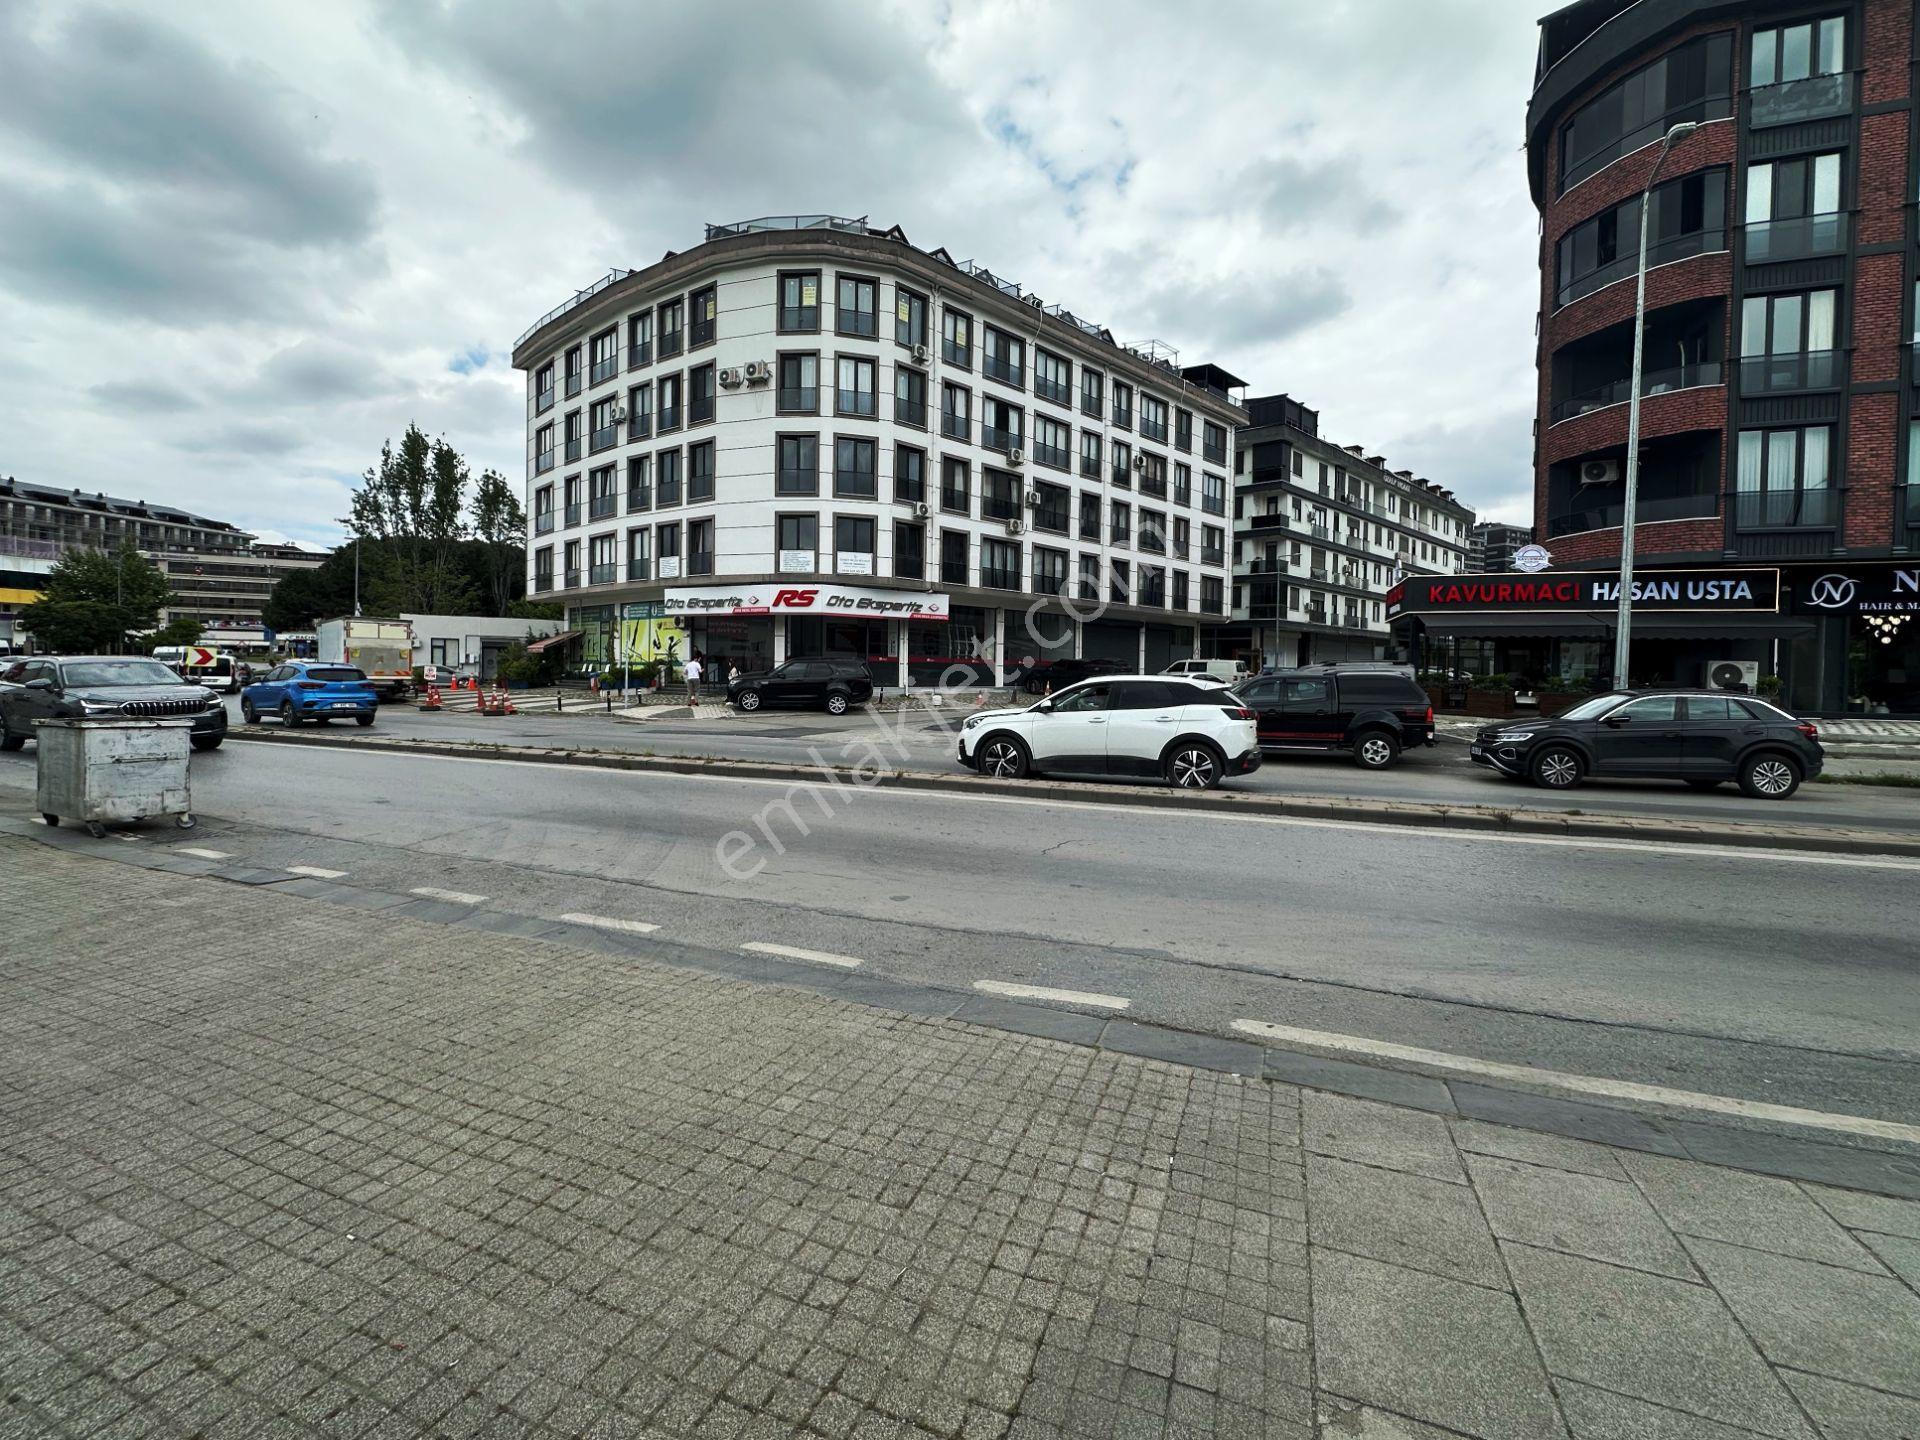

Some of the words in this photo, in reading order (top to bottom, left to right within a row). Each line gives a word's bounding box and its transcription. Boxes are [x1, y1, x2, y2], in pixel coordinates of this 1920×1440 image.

[772, 589, 819, 607] RS
[1429, 582, 1580, 603] KAVURMACI
[1687, 580, 1752, 600] USTA
[665, 598, 685, 609] Oto
[687, 596, 743, 611] Ekspertiz
[826, 595, 854, 608] Oto
[856, 597, 924, 614] Ekspertiz
[1859, 602, 1892, 610] HAIR
[1894, 602, 1904, 610] &
